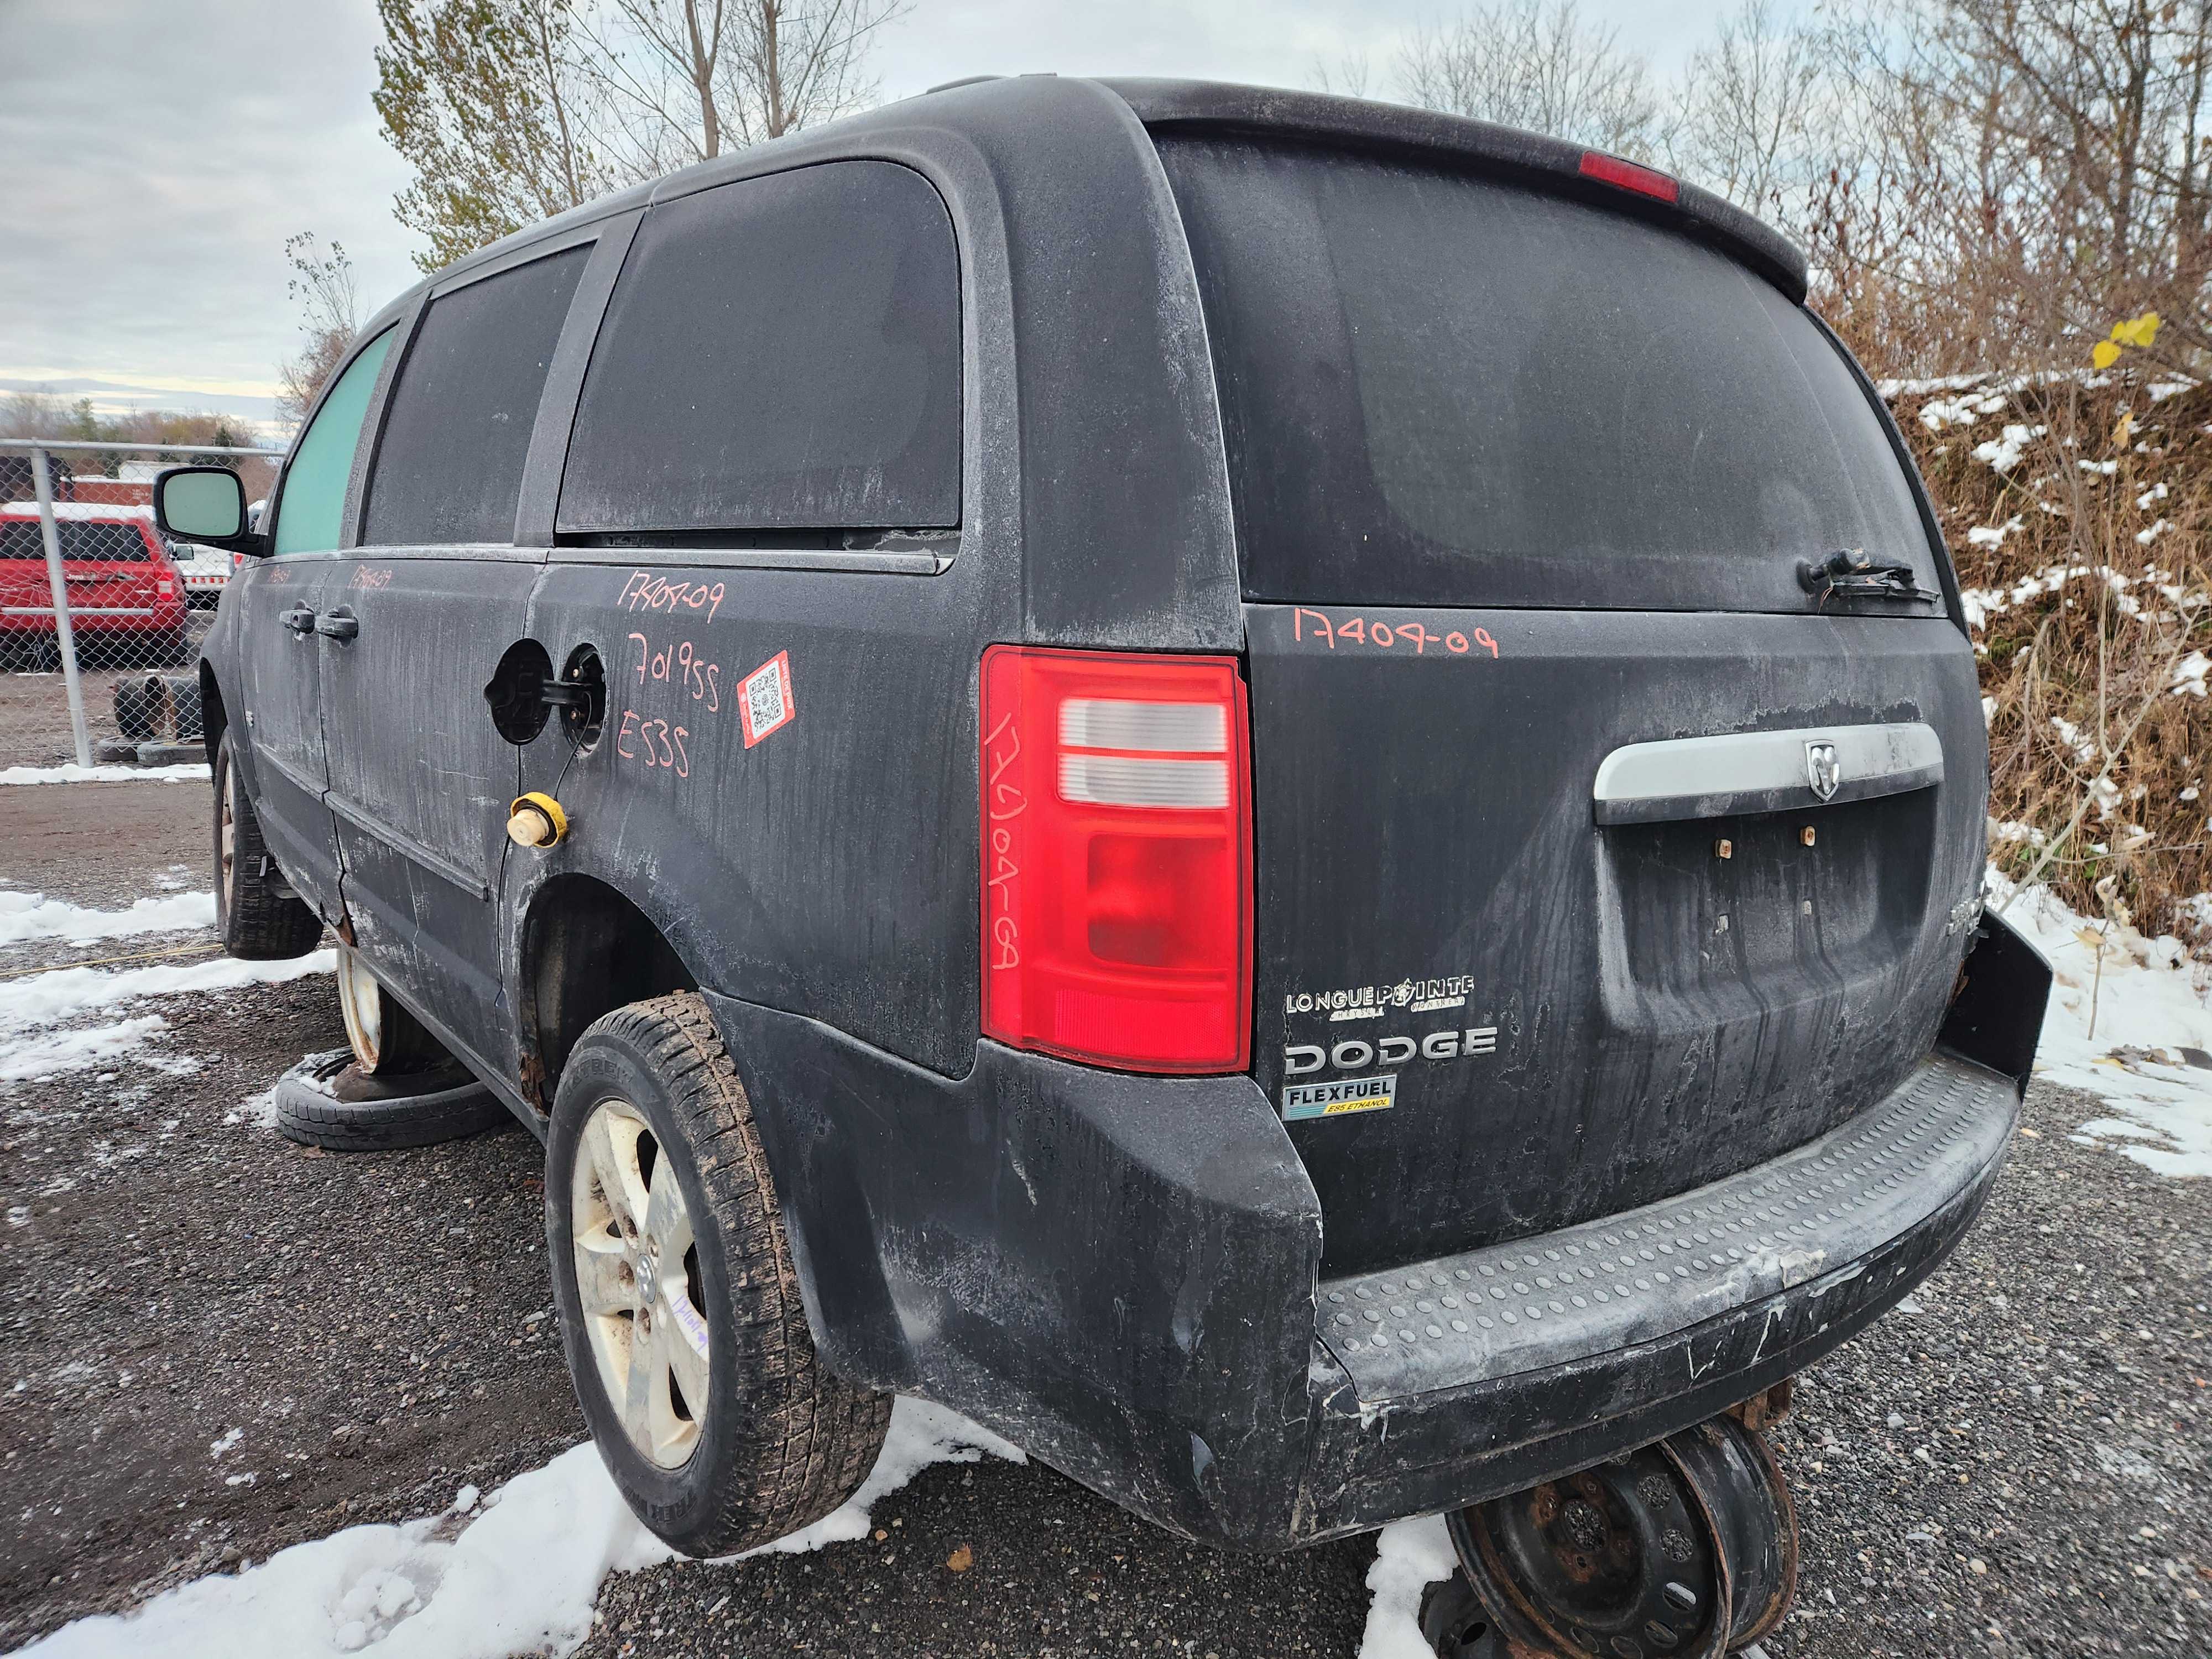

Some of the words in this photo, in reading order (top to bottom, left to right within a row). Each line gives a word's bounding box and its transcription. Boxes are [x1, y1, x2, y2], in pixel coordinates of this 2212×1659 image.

[1295, 608, 1499, 659] 17404-09
[1285, 1027, 1498, 1075] DODGE
[1290, 1082, 1391, 1105] FLEXFUEL
[1328, 1104, 1346, 1113] E85
[1347, 1099, 1387, 1110] ETHANOL
